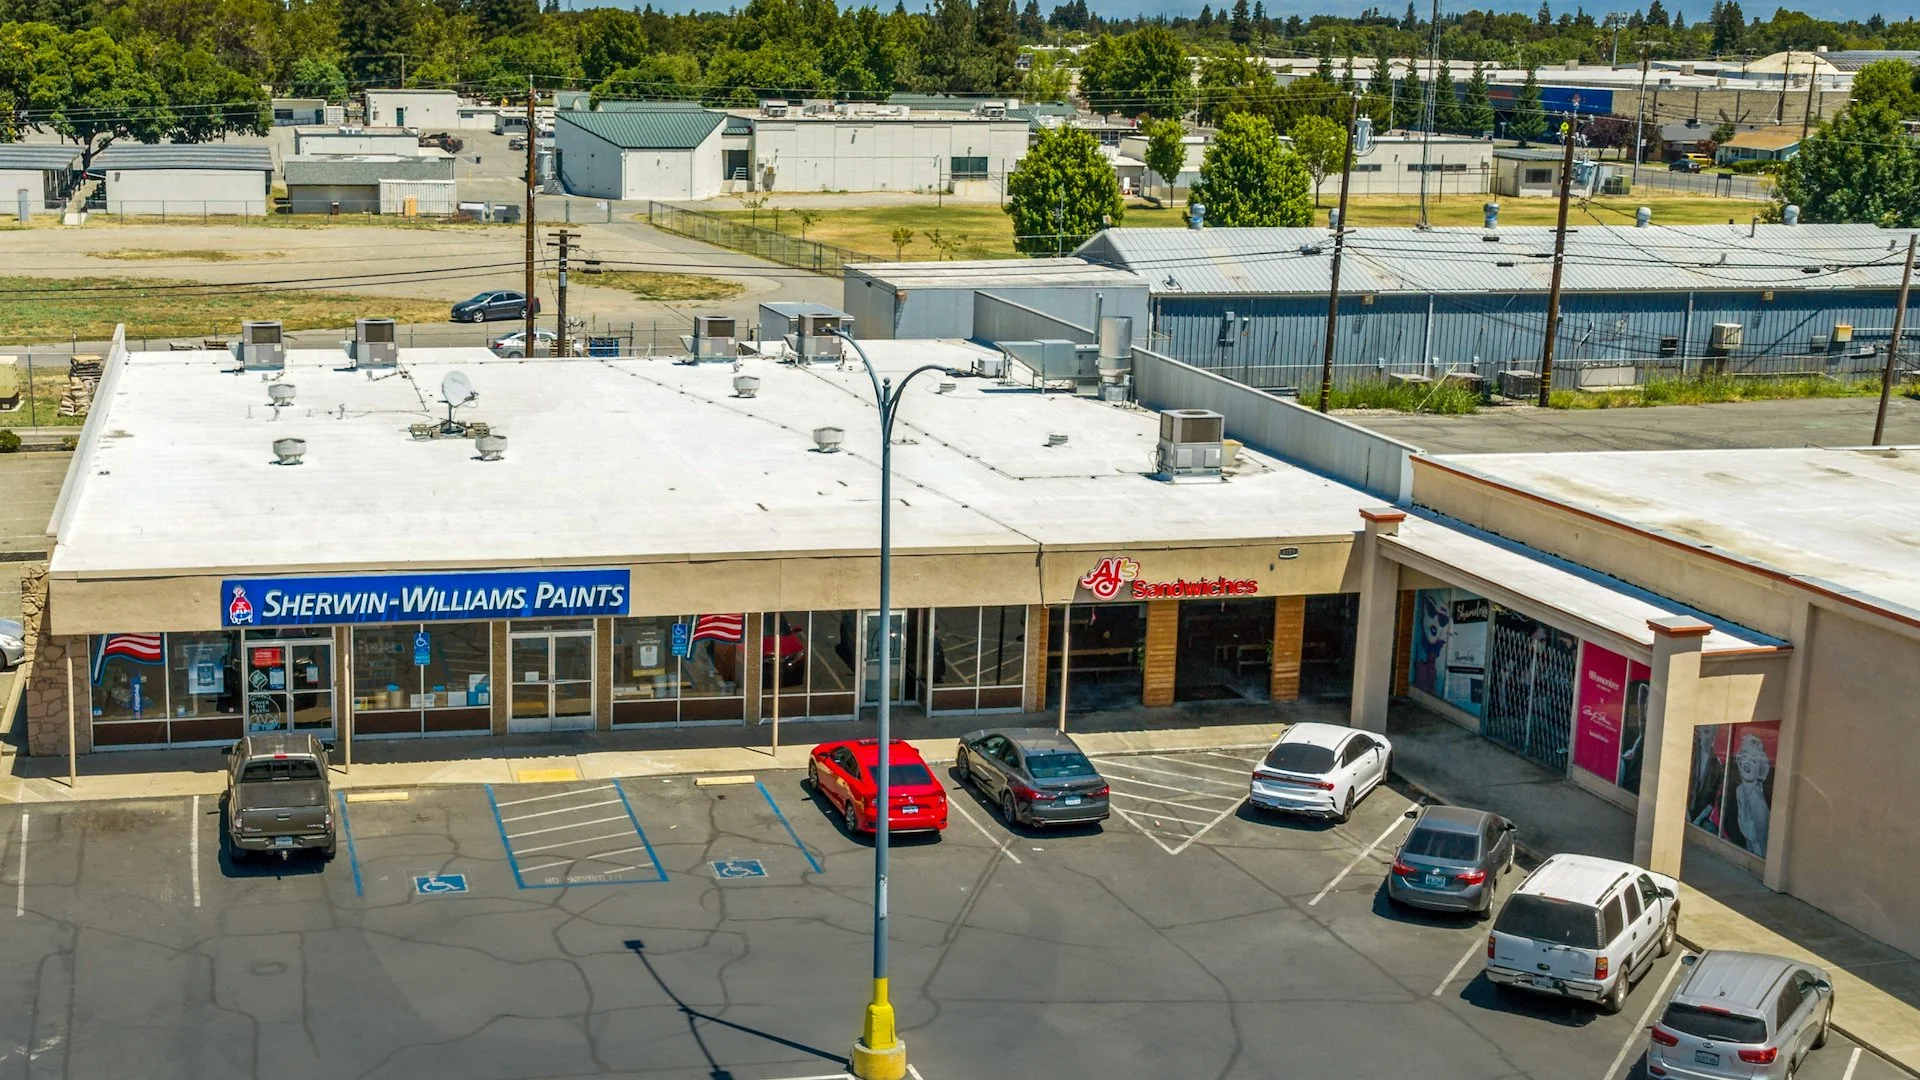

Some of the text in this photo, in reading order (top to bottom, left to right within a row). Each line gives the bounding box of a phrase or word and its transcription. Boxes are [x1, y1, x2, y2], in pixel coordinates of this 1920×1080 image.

[262, 582, 625, 617] SHERWIN-WILLIAMS PAINTS
[1131, 576, 1258, 599] Sandwiches
